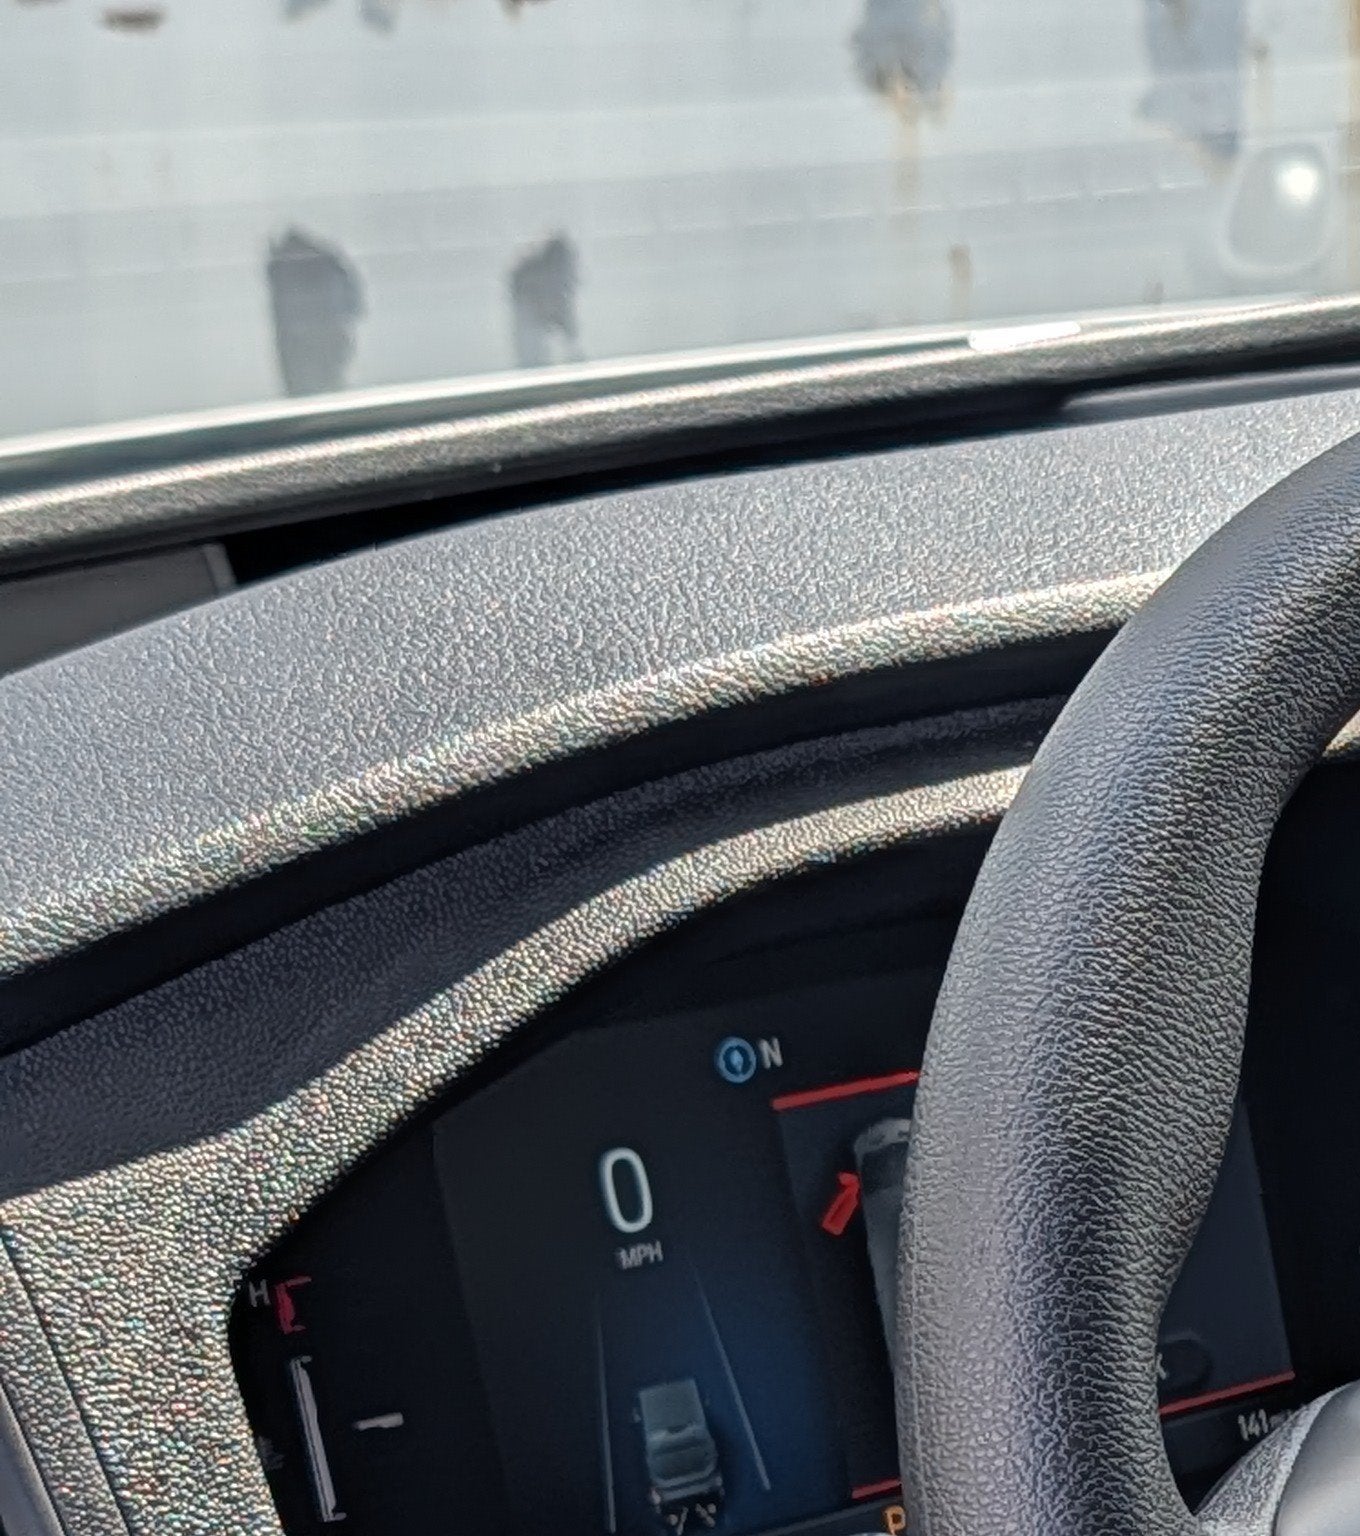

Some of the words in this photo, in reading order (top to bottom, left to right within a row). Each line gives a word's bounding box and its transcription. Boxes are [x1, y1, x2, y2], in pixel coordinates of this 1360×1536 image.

[758, 1037, 783, 1069] N
[602, 1147, 652, 1233] 0
[617, 1241, 663, 1270] MPH
[248, 1279, 271, 1307] H
